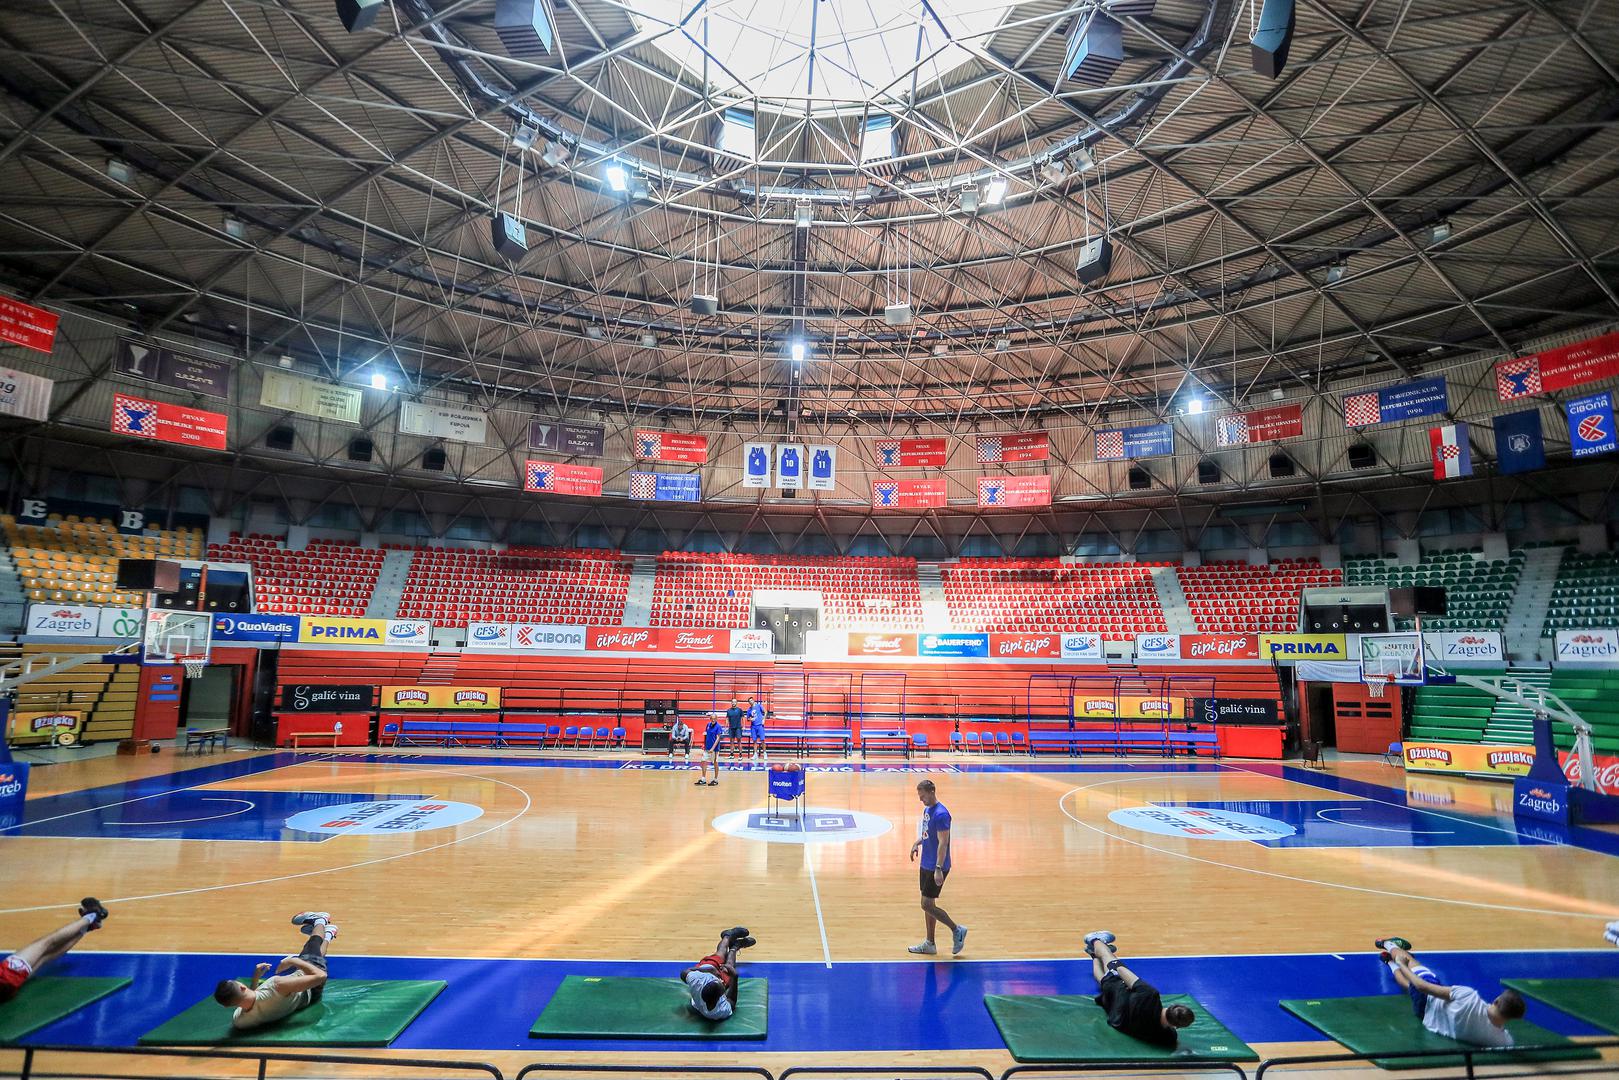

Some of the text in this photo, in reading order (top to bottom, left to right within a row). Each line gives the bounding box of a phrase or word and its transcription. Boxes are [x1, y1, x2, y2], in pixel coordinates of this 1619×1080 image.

[1567, 349, 1592, 360] PRVAK
[1541, 362, 1582, 377] REPUBLIKE
[1381, 394, 1446, 411] REPUBLIKE HRVATSKE
[1569, 399, 1609, 415] CIBONA
[157, 418, 193, 430] REPUBLIKE
[181, 413, 207, 423] PRVAK
[1574, 442, 1616, 456] ZAGREB
[754, 458, 760, 466] 4
[785, 459, 794, 467] 10
[818, 461, 826, 469] 11
[36, 616, 92, 632] Zagreb
[237, 621, 293, 632] QuoVadis
[311, 625, 380, 639] PRIMA
[534, 632, 582, 644] CIBONA
[675, 632, 714, 645] Franck
[735, 639, 768, 651] Zagreb
[1270, 642, 1340, 654] PRIMA
[1447, 643, 1498, 657] Zagreb
[1559, 643, 1618, 658] Zagreb
[311, 690, 361, 702] galić vina
[1219, 705, 1266, 716] galić vina
[1409, 747, 1450, 762] Ožujsko
[1519, 793, 1560, 814] Zagreb
[374, 810, 436, 829] ERSTE
